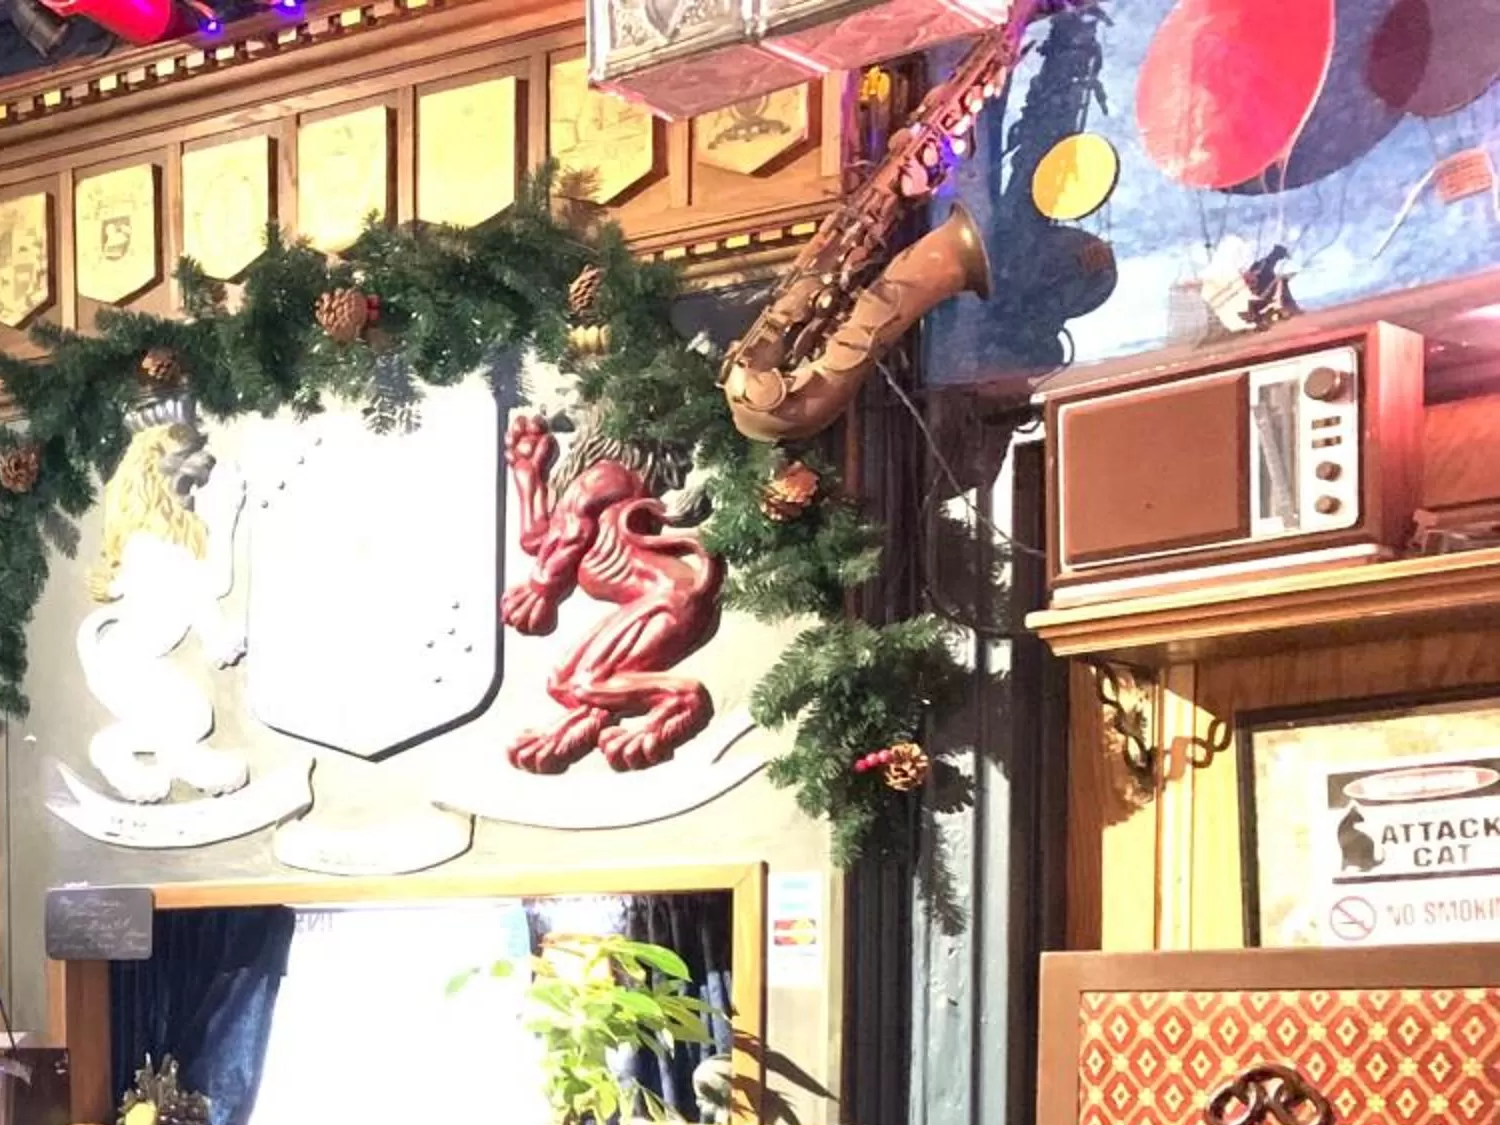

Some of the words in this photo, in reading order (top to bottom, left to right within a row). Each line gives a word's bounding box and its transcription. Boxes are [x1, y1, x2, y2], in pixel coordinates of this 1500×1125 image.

[1381, 816, 1500, 845] ATTACK
[1413, 843, 1471, 867] CAT
[1385, 902, 1415, 926] NO
